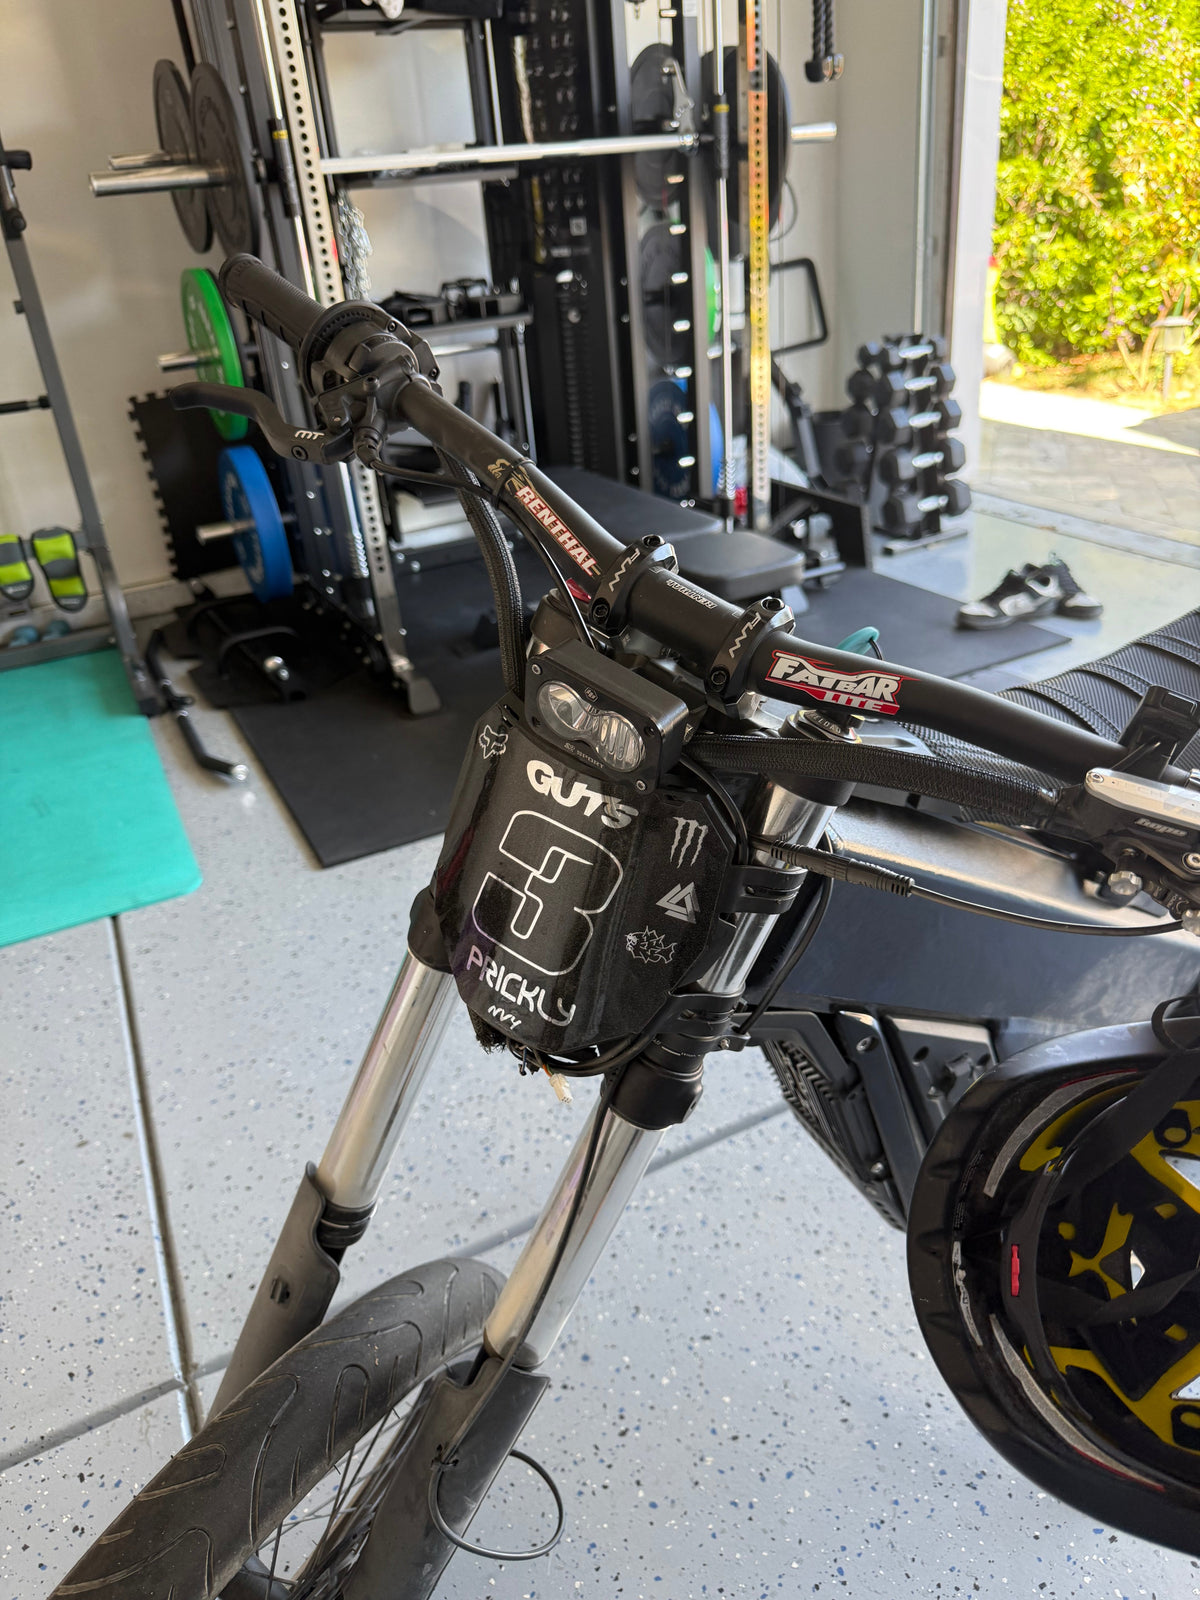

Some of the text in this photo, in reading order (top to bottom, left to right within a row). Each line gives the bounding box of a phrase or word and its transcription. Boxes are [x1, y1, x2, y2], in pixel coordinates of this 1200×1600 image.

[515, 485, 597, 577] RENTHAL
[769, 652, 902, 703] FATBAR
[824, 690, 885, 714] LITE
[526, 759, 640, 829] GUTS
[471, 809, 624, 976] 3
[466, 944, 577, 1027] PRICKLY
